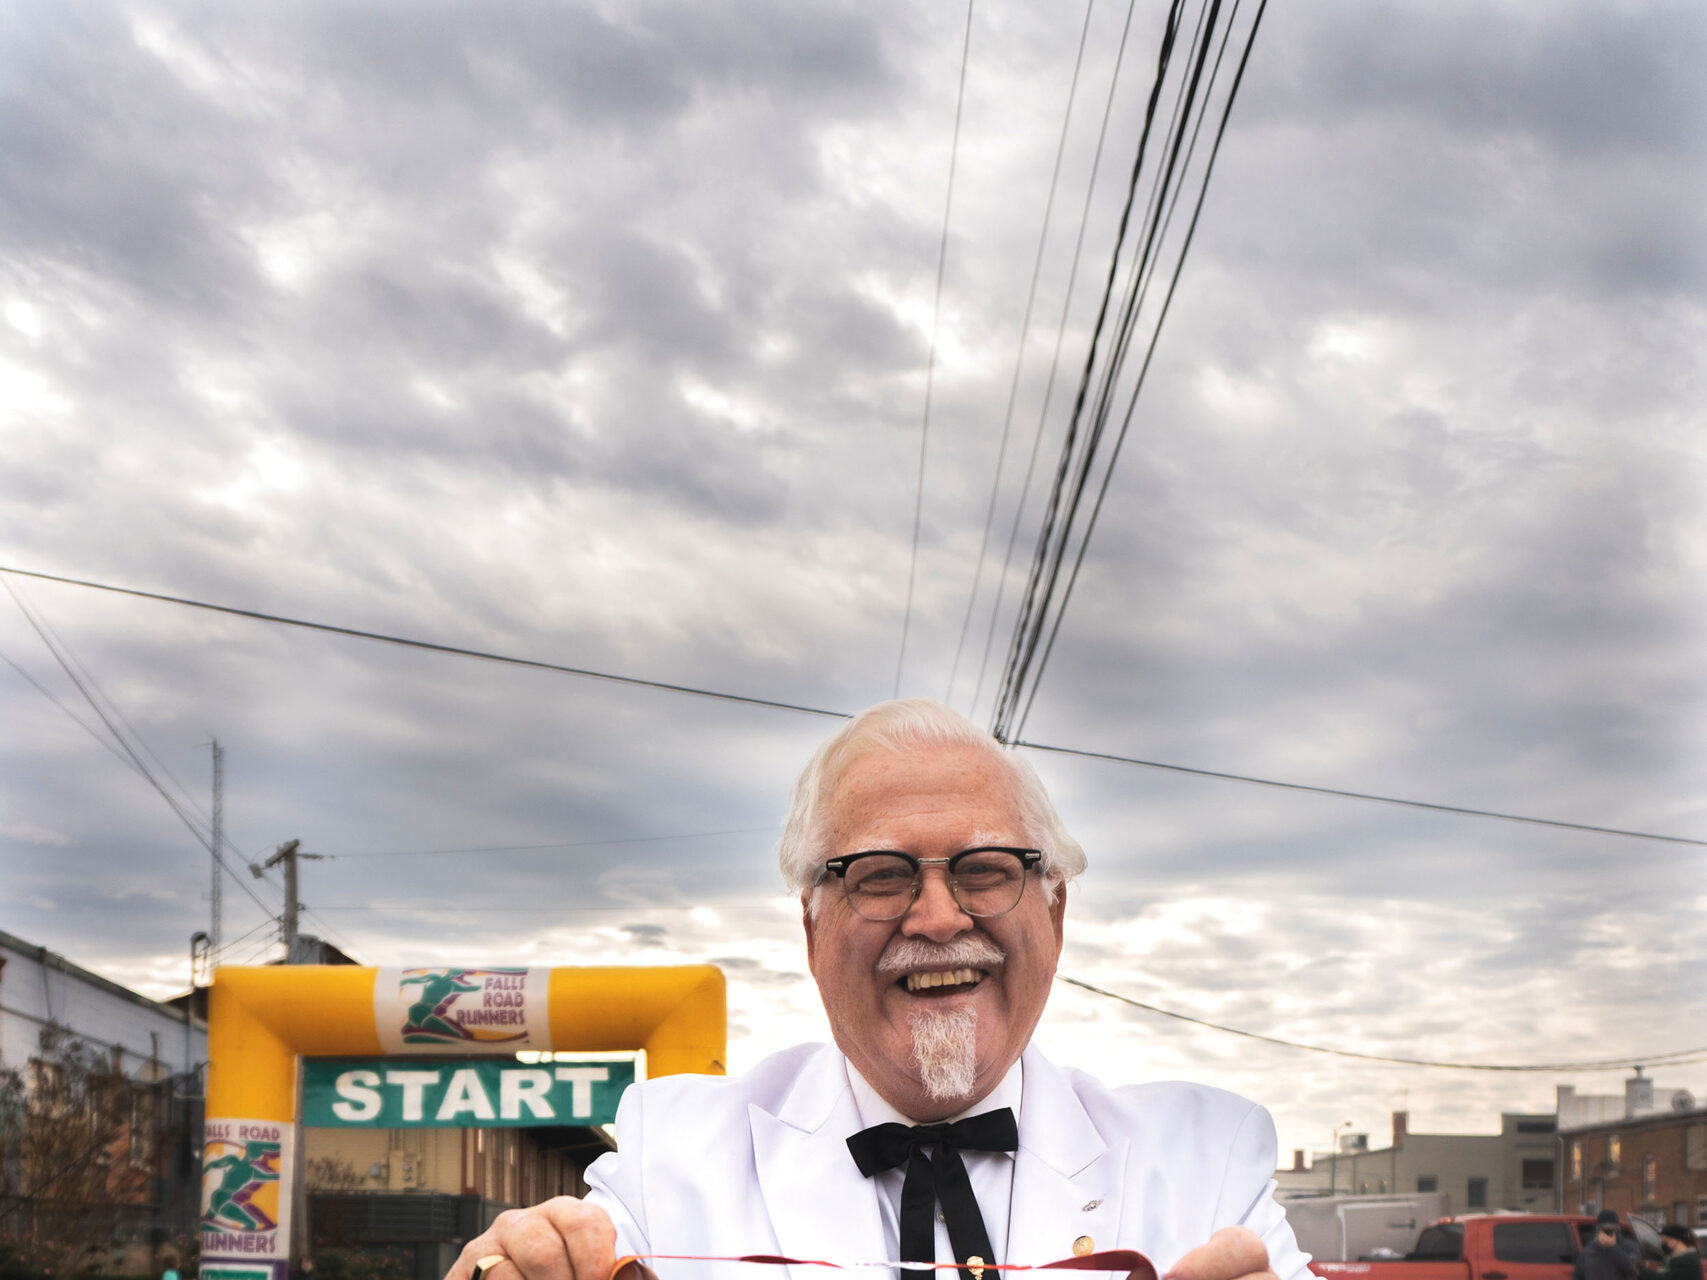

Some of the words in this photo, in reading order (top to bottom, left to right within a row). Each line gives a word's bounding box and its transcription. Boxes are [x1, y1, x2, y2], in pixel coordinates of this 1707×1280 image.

[484, 976, 525, 991] FALLS
[482, 991, 525, 1008] ROAD
[456, 1008, 525, 1025] RUNNERS
[331, 1067, 609, 1122] START
[205, 1123, 230, 1138] ALLS
[239, 1125, 280, 1141] ROAD
